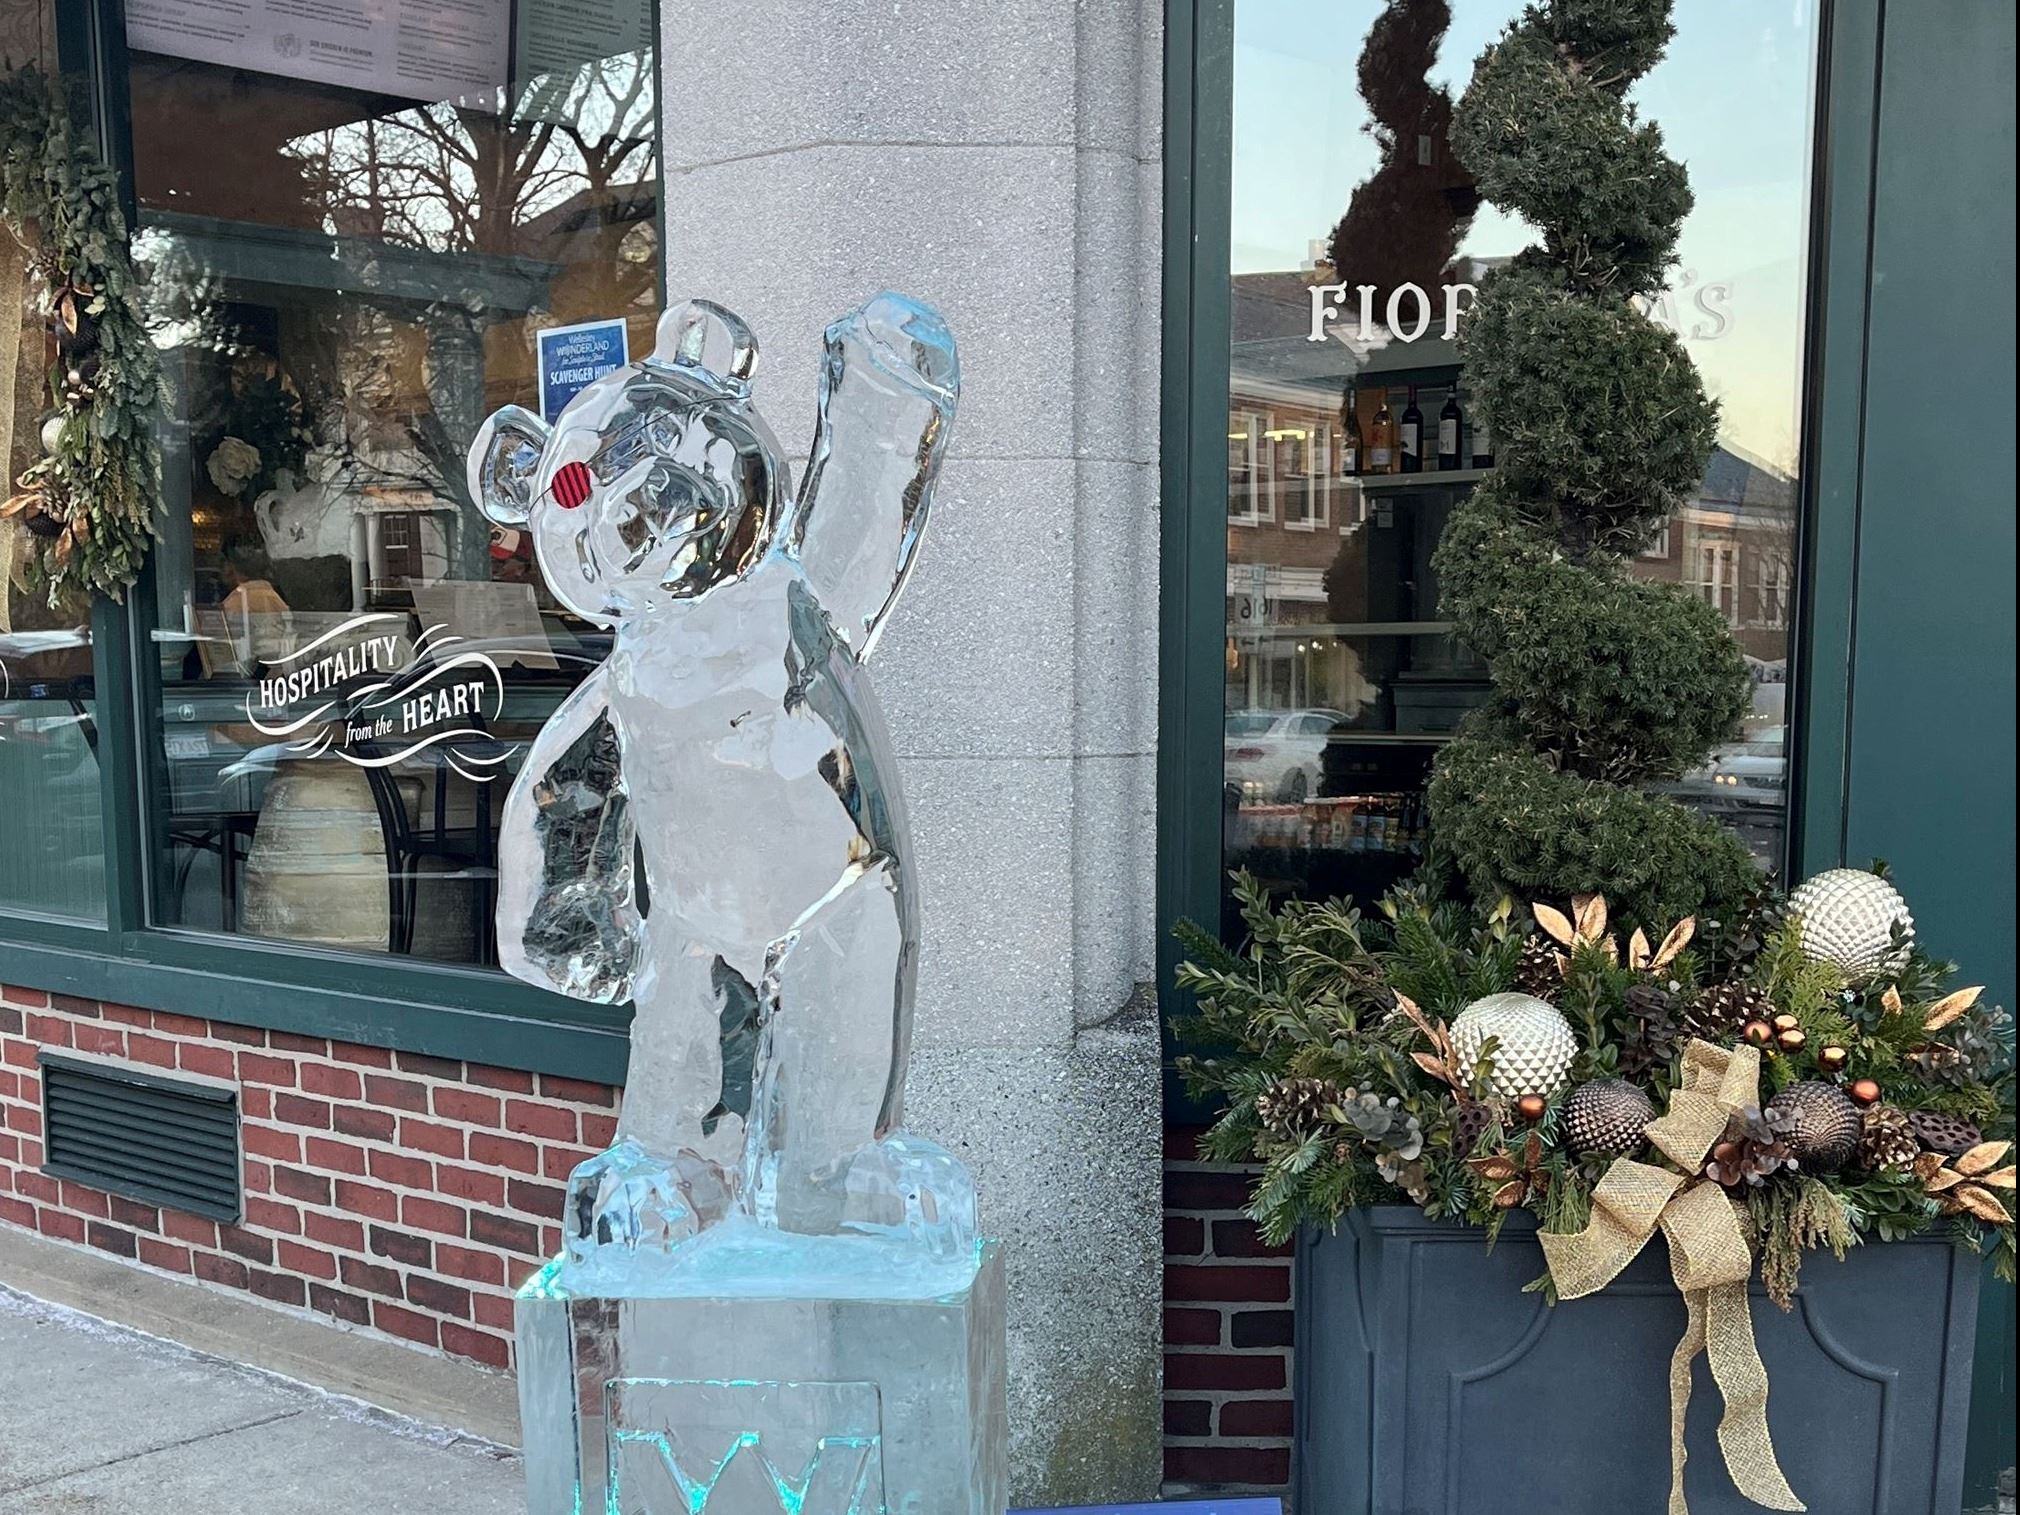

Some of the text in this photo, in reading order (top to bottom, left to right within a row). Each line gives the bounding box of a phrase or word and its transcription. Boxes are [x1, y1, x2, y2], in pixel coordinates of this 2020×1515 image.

[550, 367, 594, 386] SCAVENGER
[259, 635, 398, 708] HOSPITALITY
[344, 681, 485, 749] from the HEART
